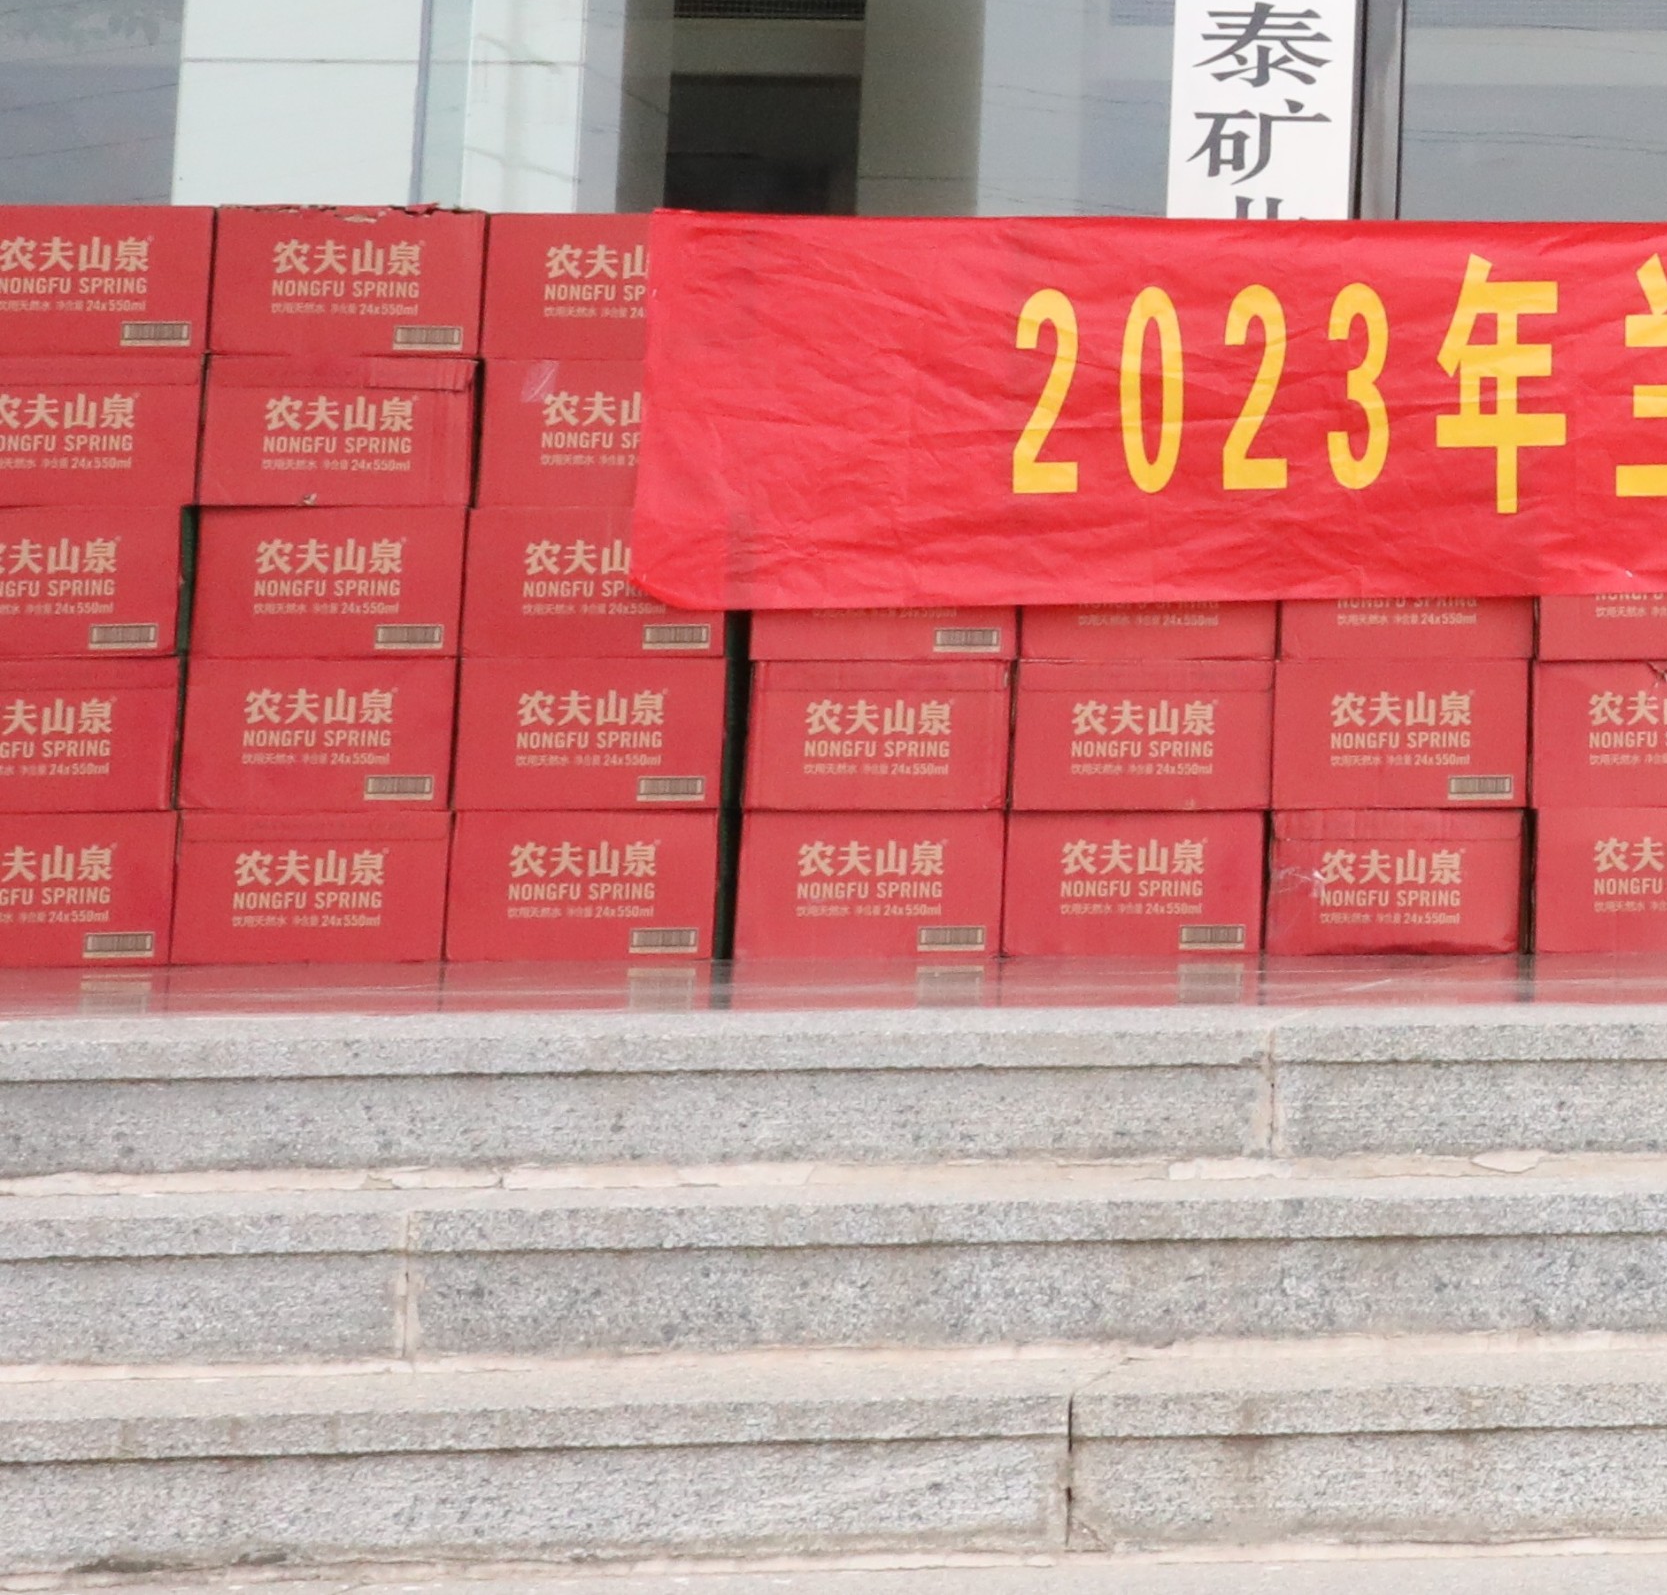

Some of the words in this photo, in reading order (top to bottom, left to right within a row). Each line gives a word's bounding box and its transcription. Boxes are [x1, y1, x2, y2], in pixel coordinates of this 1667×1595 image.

[271, 238, 423, 278] 农夫山泉
[270, 278, 346, 299] NONGFU
[352, 279, 421, 300] SPRING
[262, 393, 416, 433] 农夫山泉
[260, 435, 338, 455] NONGFU
[344, 435, 414, 455] SPRING
[253, 536, 404, 576] 农夫山泉
[242, 686, 395, 726] 农夫山泉
[515, 688, 666, 727] 农夫山泉
[803, 698, 954, 736] 农夫山泉
[1070, 698, 1217, 737] 农夫山泉
[1328, 689, 1475, 728] 农夫山泉
[241, 728, 317, 748] NONGFU
[323, 728, 393, 748] SPRING
[802, 739, 877, 759] NONGFU
[883, 739, 952, 759] SPRING
[1069, 740, 1143, 759] NONGFU
[1148, 740, 1215, 759] SPRING
[1328, 730, 1401, 750] NONGFU
[1407, 730, 1473, 750] SPRING
[1586, 729, 1659, 749] NONGFU
[232, 847, 387, 888] 农夫山泉
[506, 839, 659, 879] 农夫山泉
[795, 838, 946, 878] 农夫山泉
[1058, 837, 1206, 876] 农夫山泉
[1321, 848, 1463, 886] 农夫山泉
[230, 890, 308, 911] NONGFU
[314, 890, 385, 911] SPRING
[795, 880, 870, 902] NONGFU
[876, 880, 944, 902] SPRING
[1058, 879, 1132, 899] NONGFU
[1138, 879, 1204, 899] SPRING
[1320, 888, 1391, 908] NONGFU
[1397, 888, 1461, 908] SPRING
[1592, 876, 1664, 896] NONGFU
